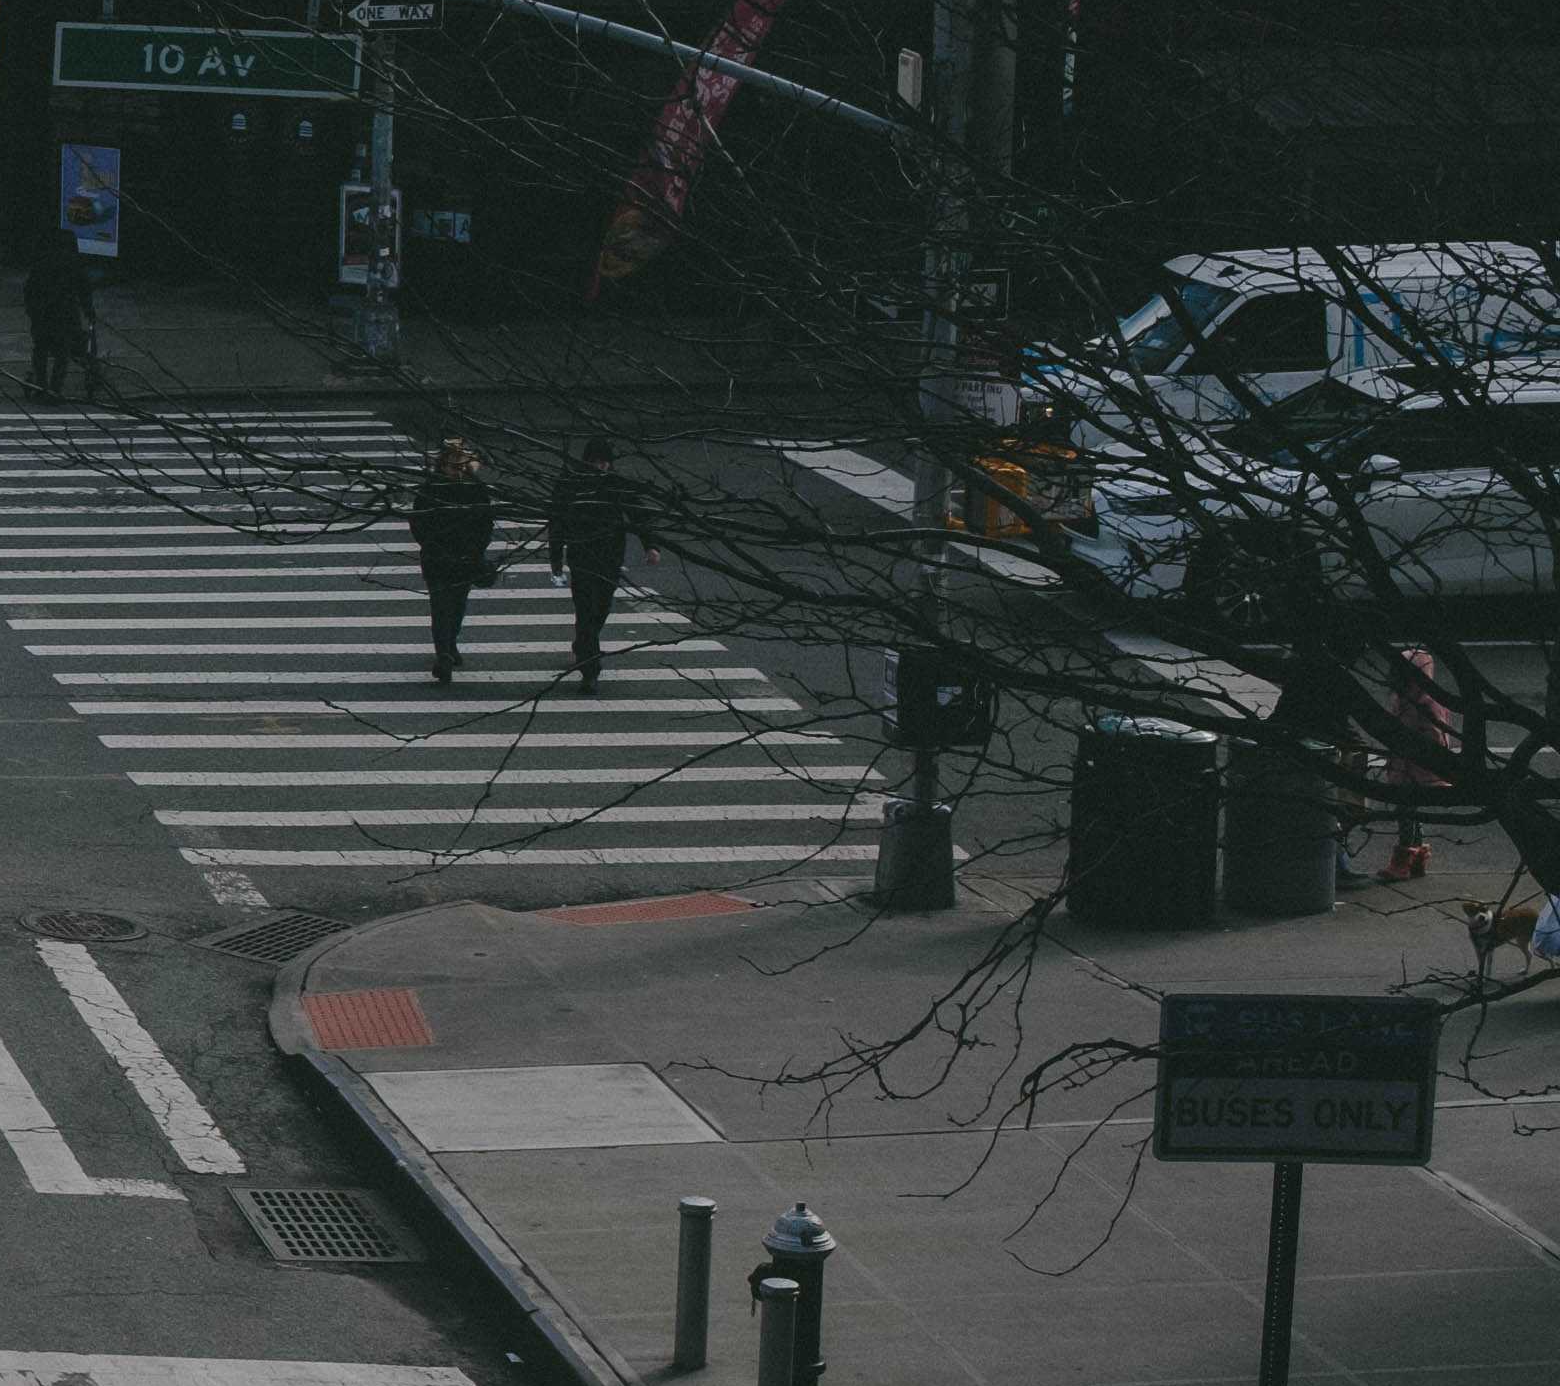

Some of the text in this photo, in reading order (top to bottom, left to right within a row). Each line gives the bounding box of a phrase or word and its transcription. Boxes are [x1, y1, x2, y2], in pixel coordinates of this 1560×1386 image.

[356, 4, 431, 21] ONE WAY
[141, 43, 186, 75] 10
[1237, 1052, 1358, 1073] AHEAD
[1175, 1097, 1412, 1131] BUSES ONLY
